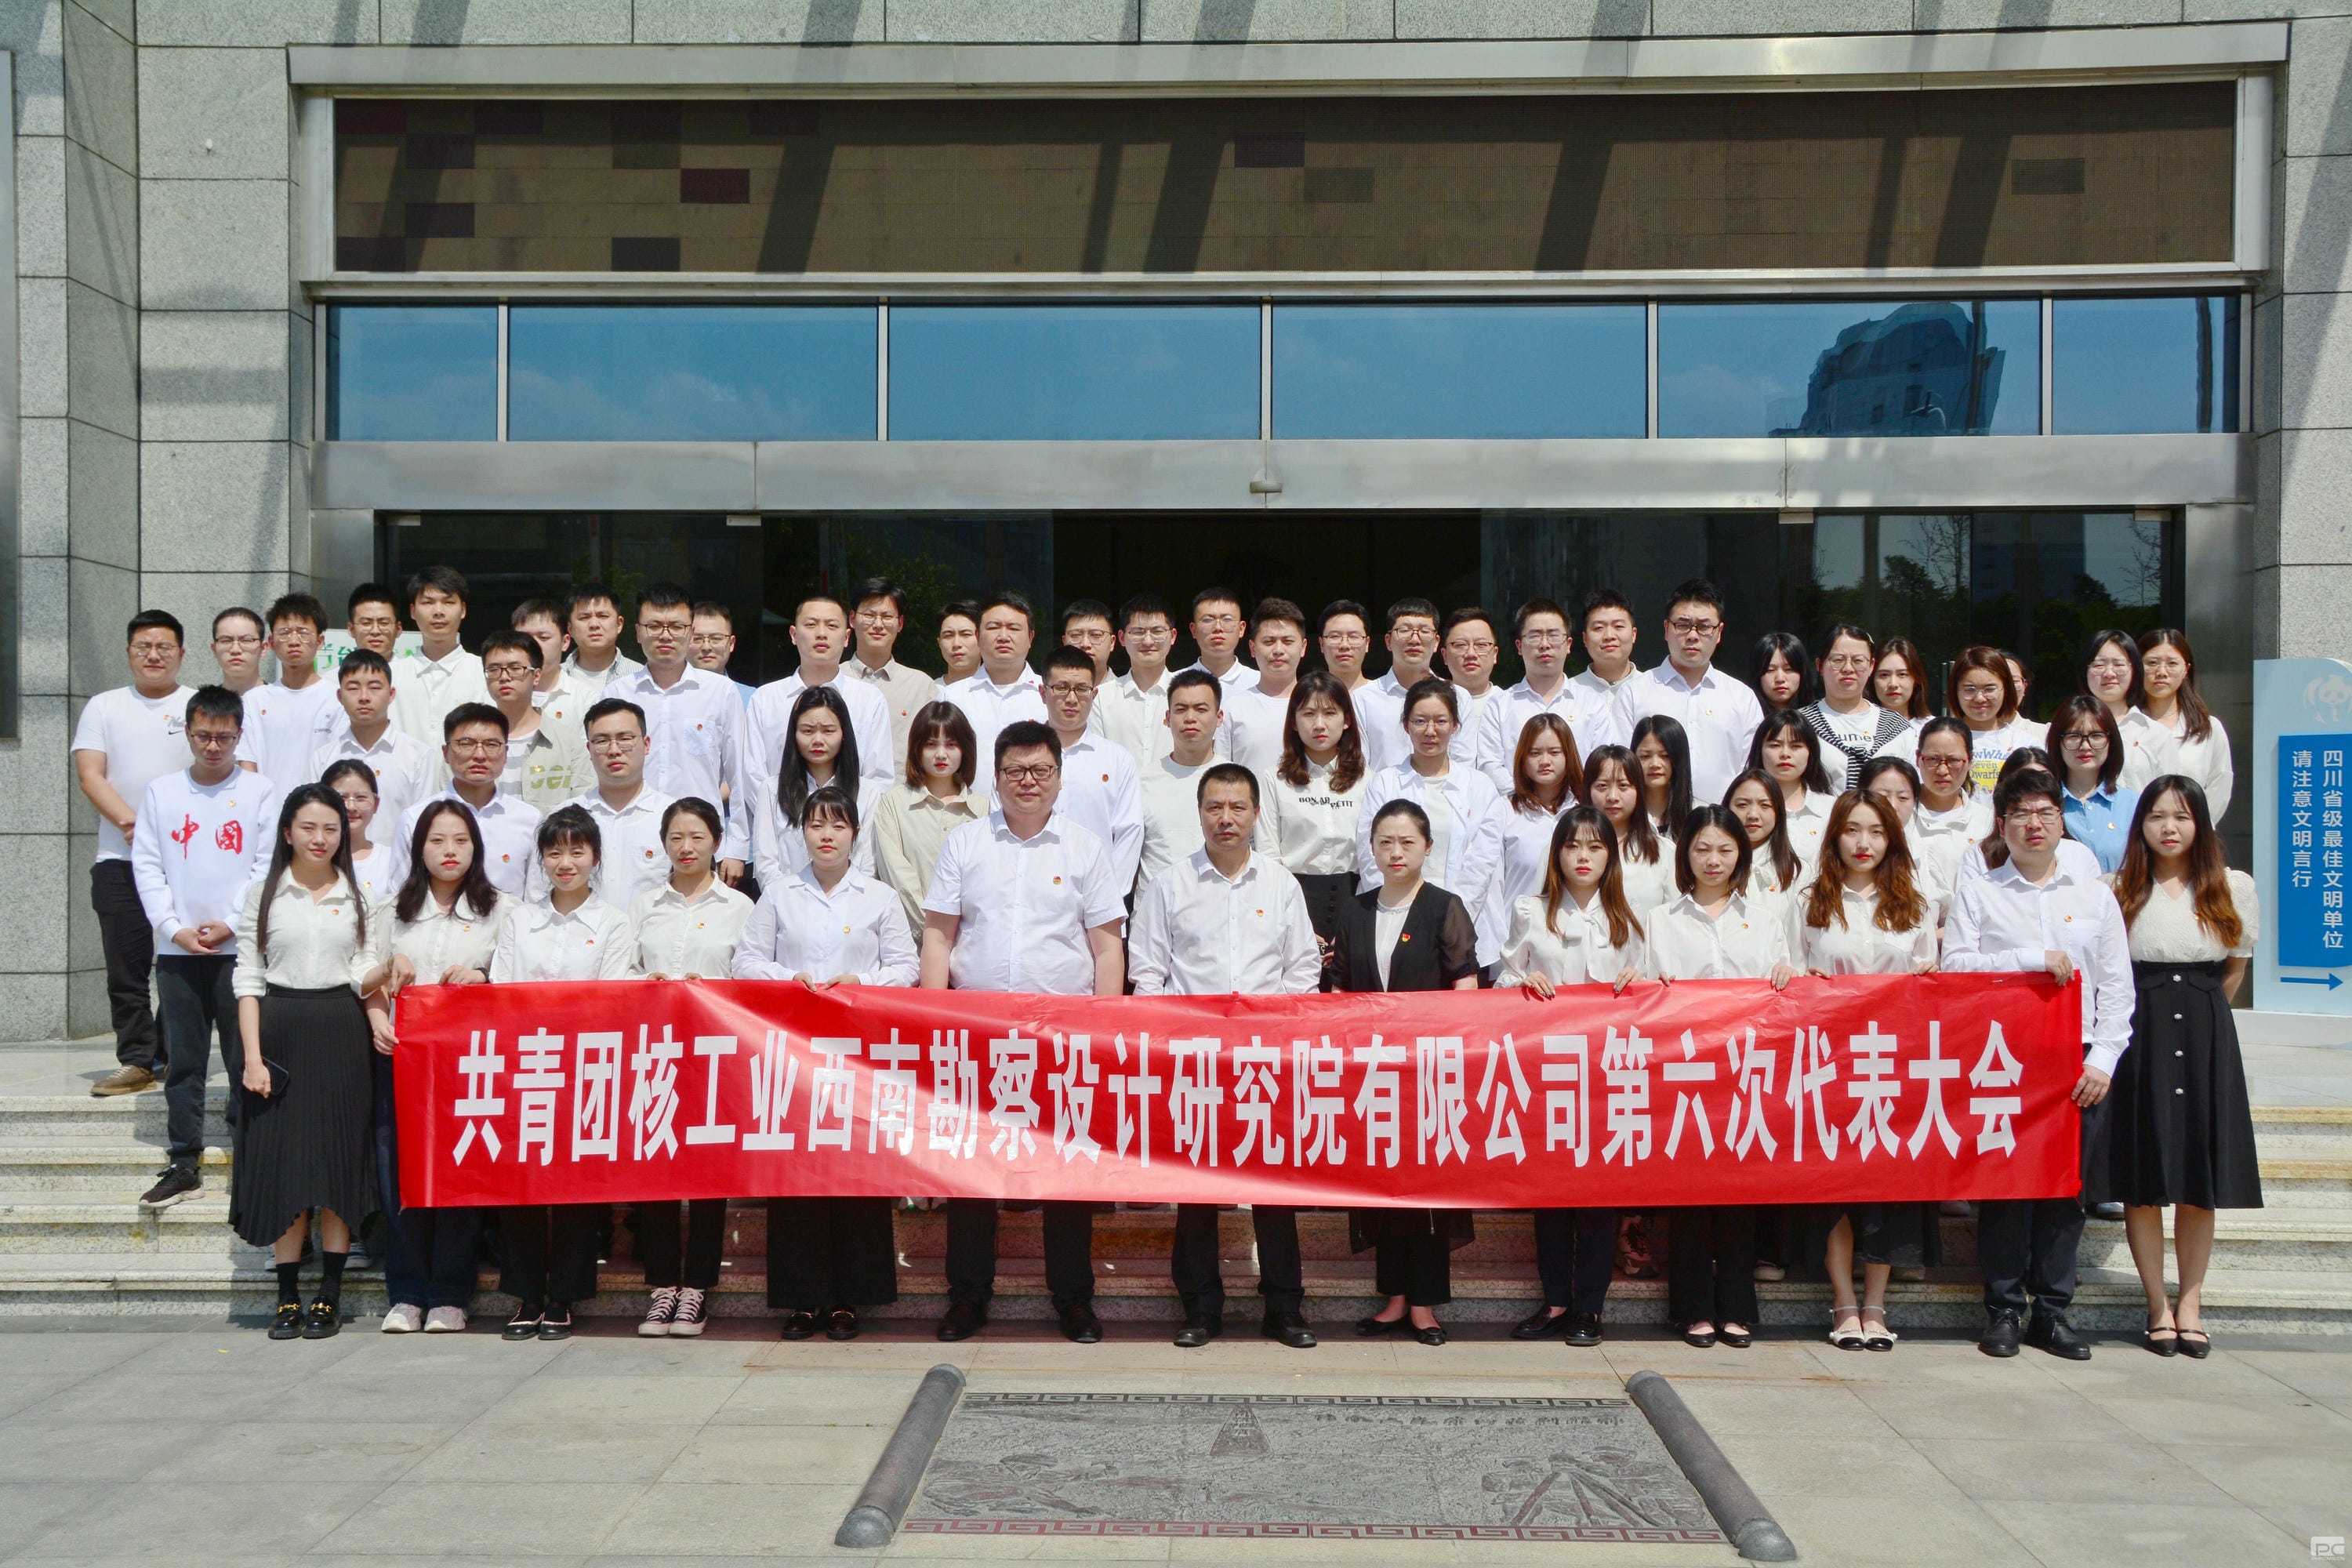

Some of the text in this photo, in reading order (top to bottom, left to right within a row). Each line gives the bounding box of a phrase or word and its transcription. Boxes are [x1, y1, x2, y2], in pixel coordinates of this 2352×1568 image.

[2292, 750, 2313, 887] 请注意文明言行
[2322, 750, 2344, 949] 四川省级最佳文明单位
[453, 1020, 2023, 1168] 共青团核工业西南勘察设计研究院有限公司第六次代表大会
